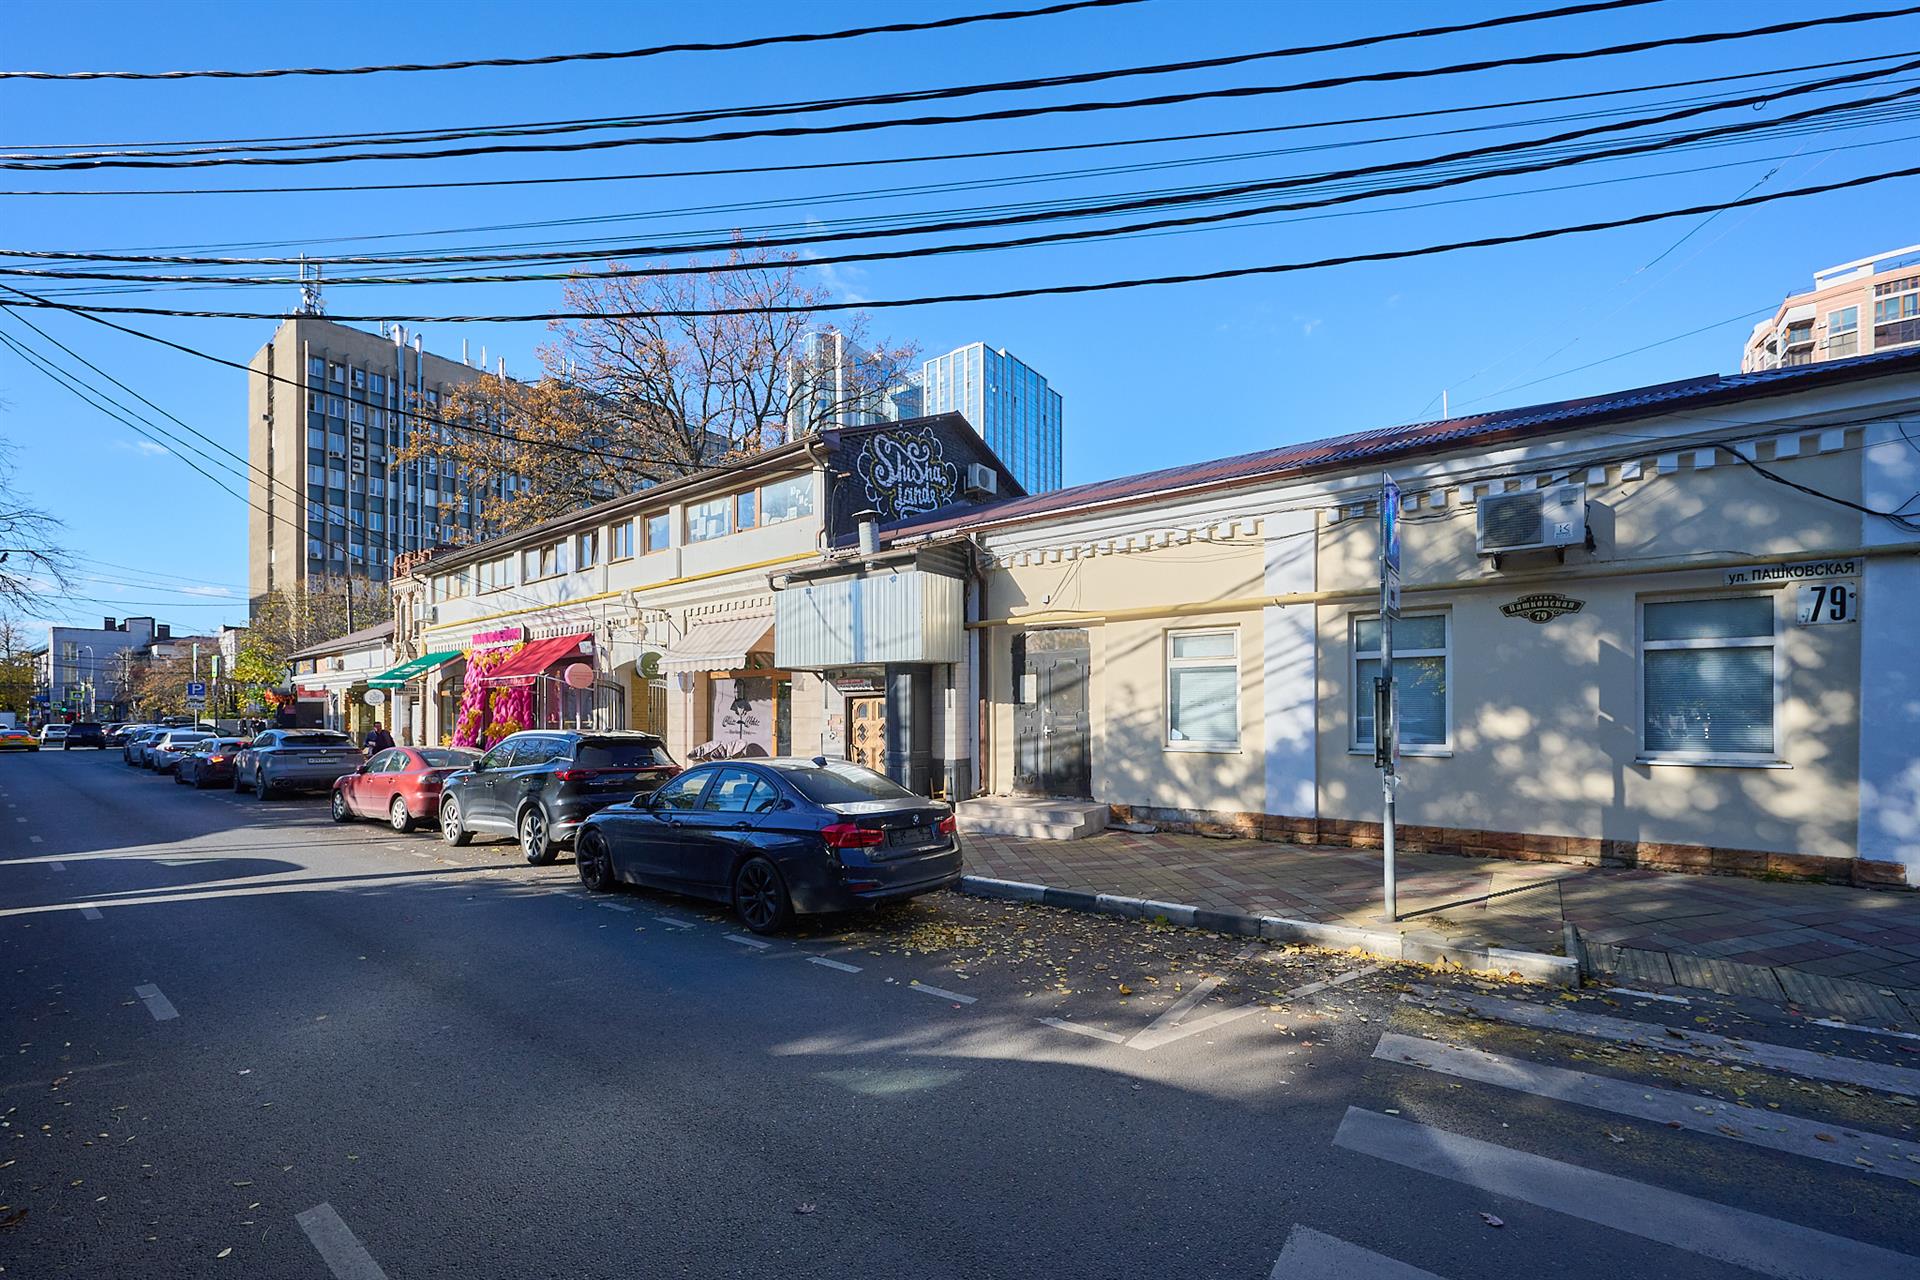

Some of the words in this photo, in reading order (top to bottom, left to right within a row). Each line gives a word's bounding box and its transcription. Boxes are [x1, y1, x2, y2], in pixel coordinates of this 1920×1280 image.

[1728, 573, 1748, 585] ул.
[1752, 561, 1855, 581] ПАШКОВСКАЯ
[1508, 600, 1575, 613] Пашковская
[1810, 585, 1847, 622] 79
[1534, 611, 1548, 621] 79
